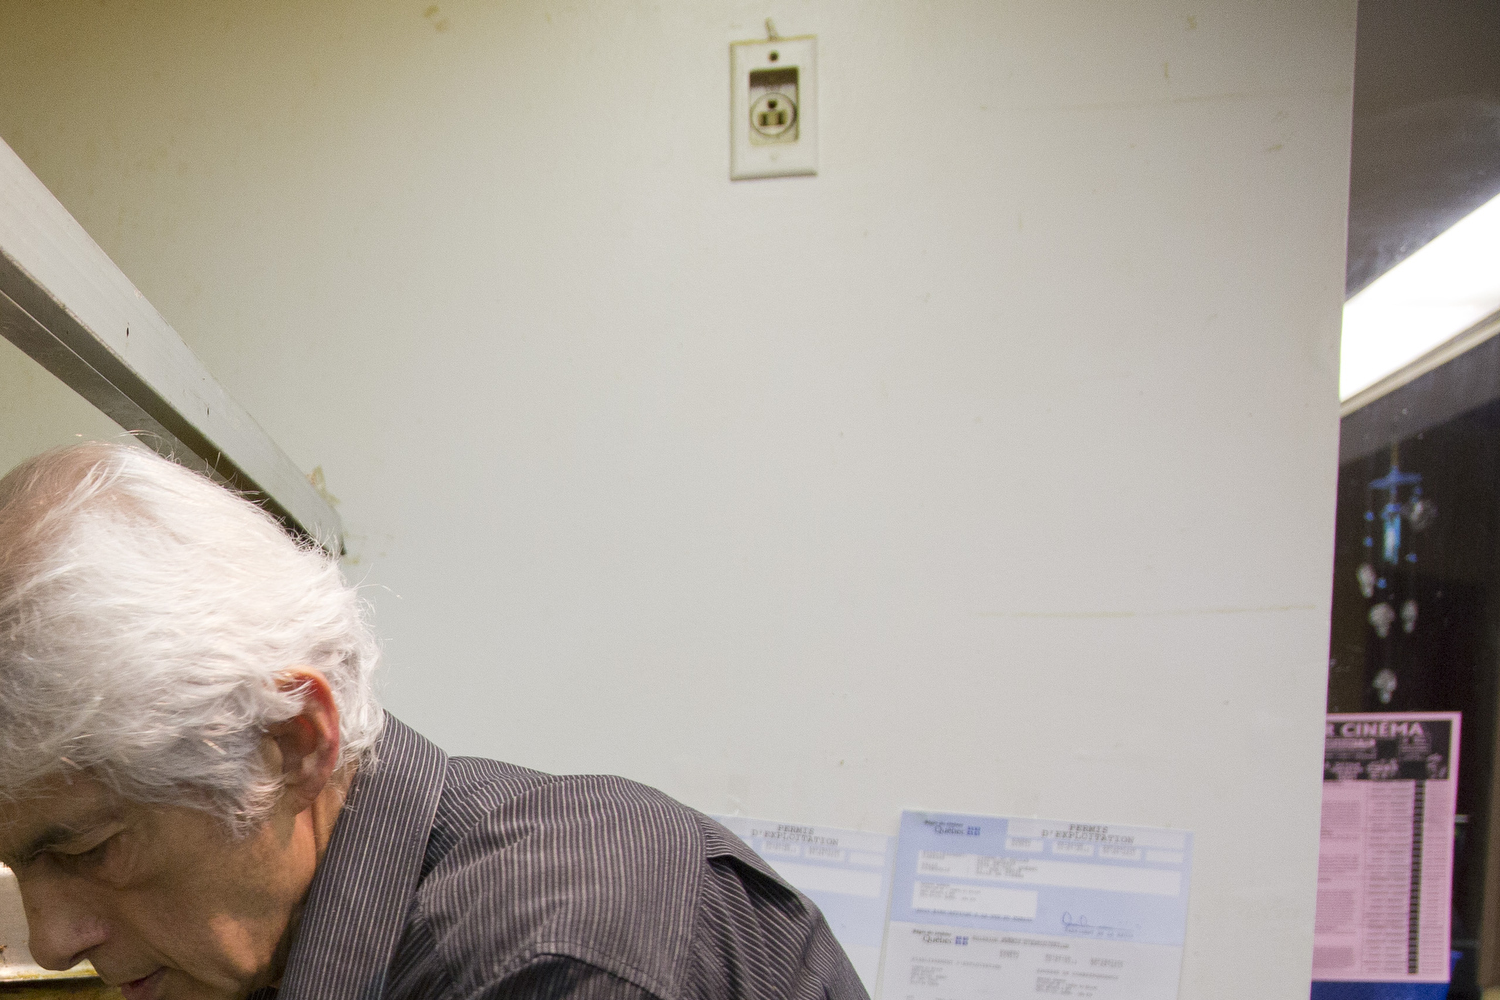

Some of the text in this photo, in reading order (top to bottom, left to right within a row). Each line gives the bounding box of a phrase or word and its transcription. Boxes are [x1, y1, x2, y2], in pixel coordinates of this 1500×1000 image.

[778, 824, 815, 835] PERMIS
[1069, 823, 1109, 834] PERMIS
[751, 829, 840, 846] D'EXPLOITATION
[1041, 829, 1135, 845] D'EXPLOITATION
